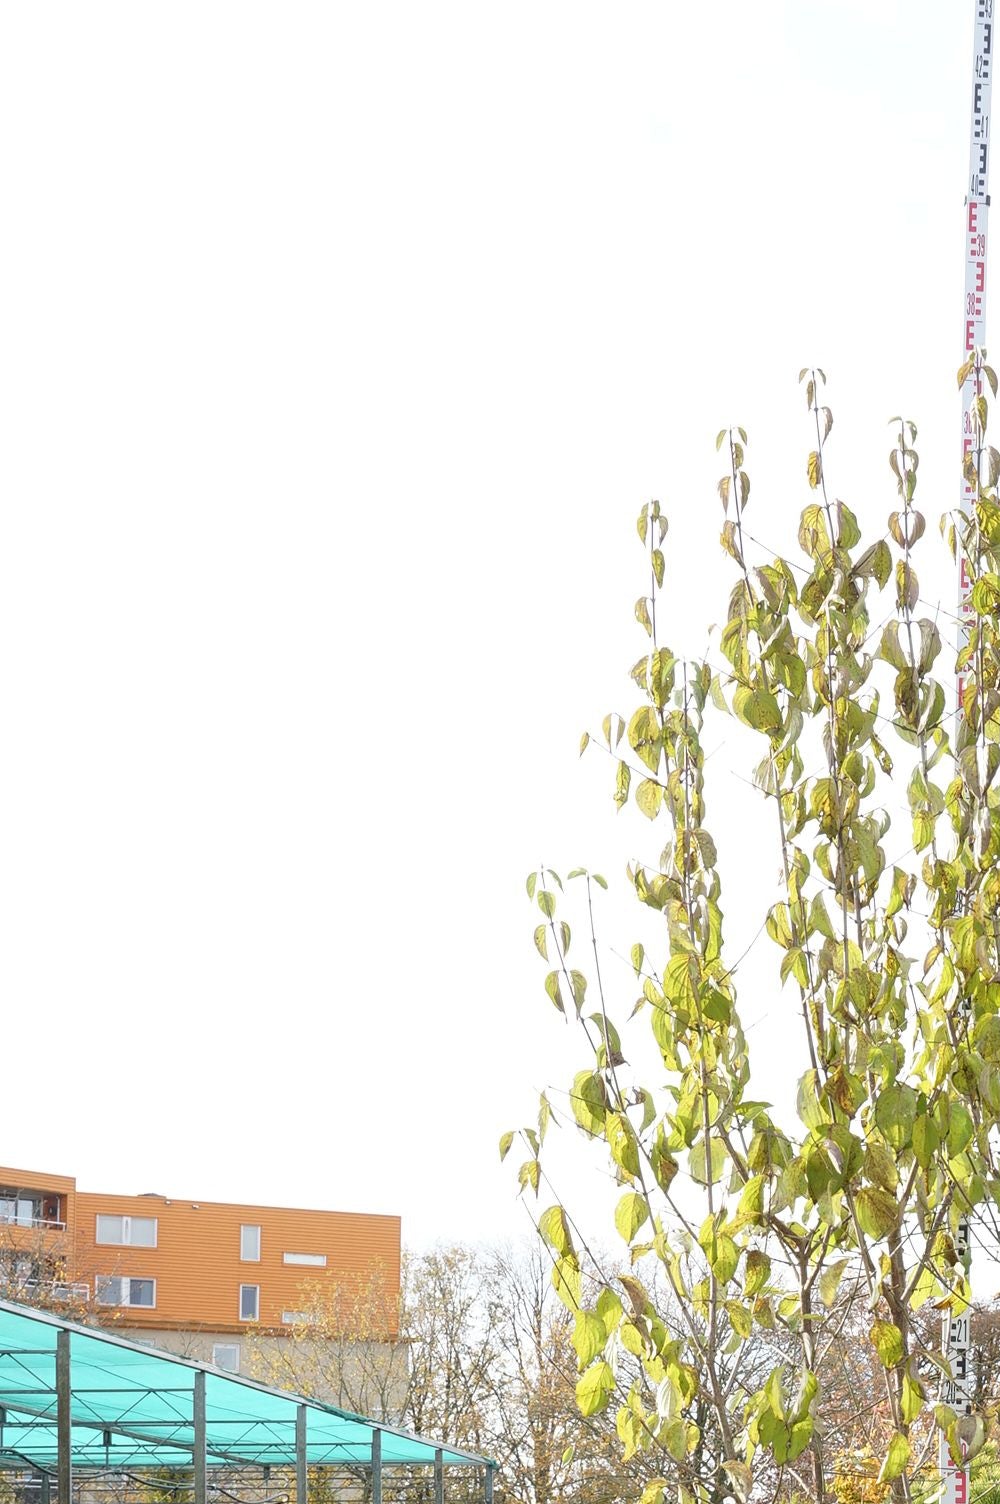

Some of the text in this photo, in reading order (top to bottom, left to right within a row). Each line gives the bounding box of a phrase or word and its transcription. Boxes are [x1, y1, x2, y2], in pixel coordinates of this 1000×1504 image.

[975, 55, 983, 78] 42
[980, 115, 989, 138] 41
[970, 174, 979, 196] 40
[976, 234, 985, 257] 39
[967, 293, 976, 316] 38
[957, 1318, 967, 1342] 21
[945, 1381, 956, 1404] 20
